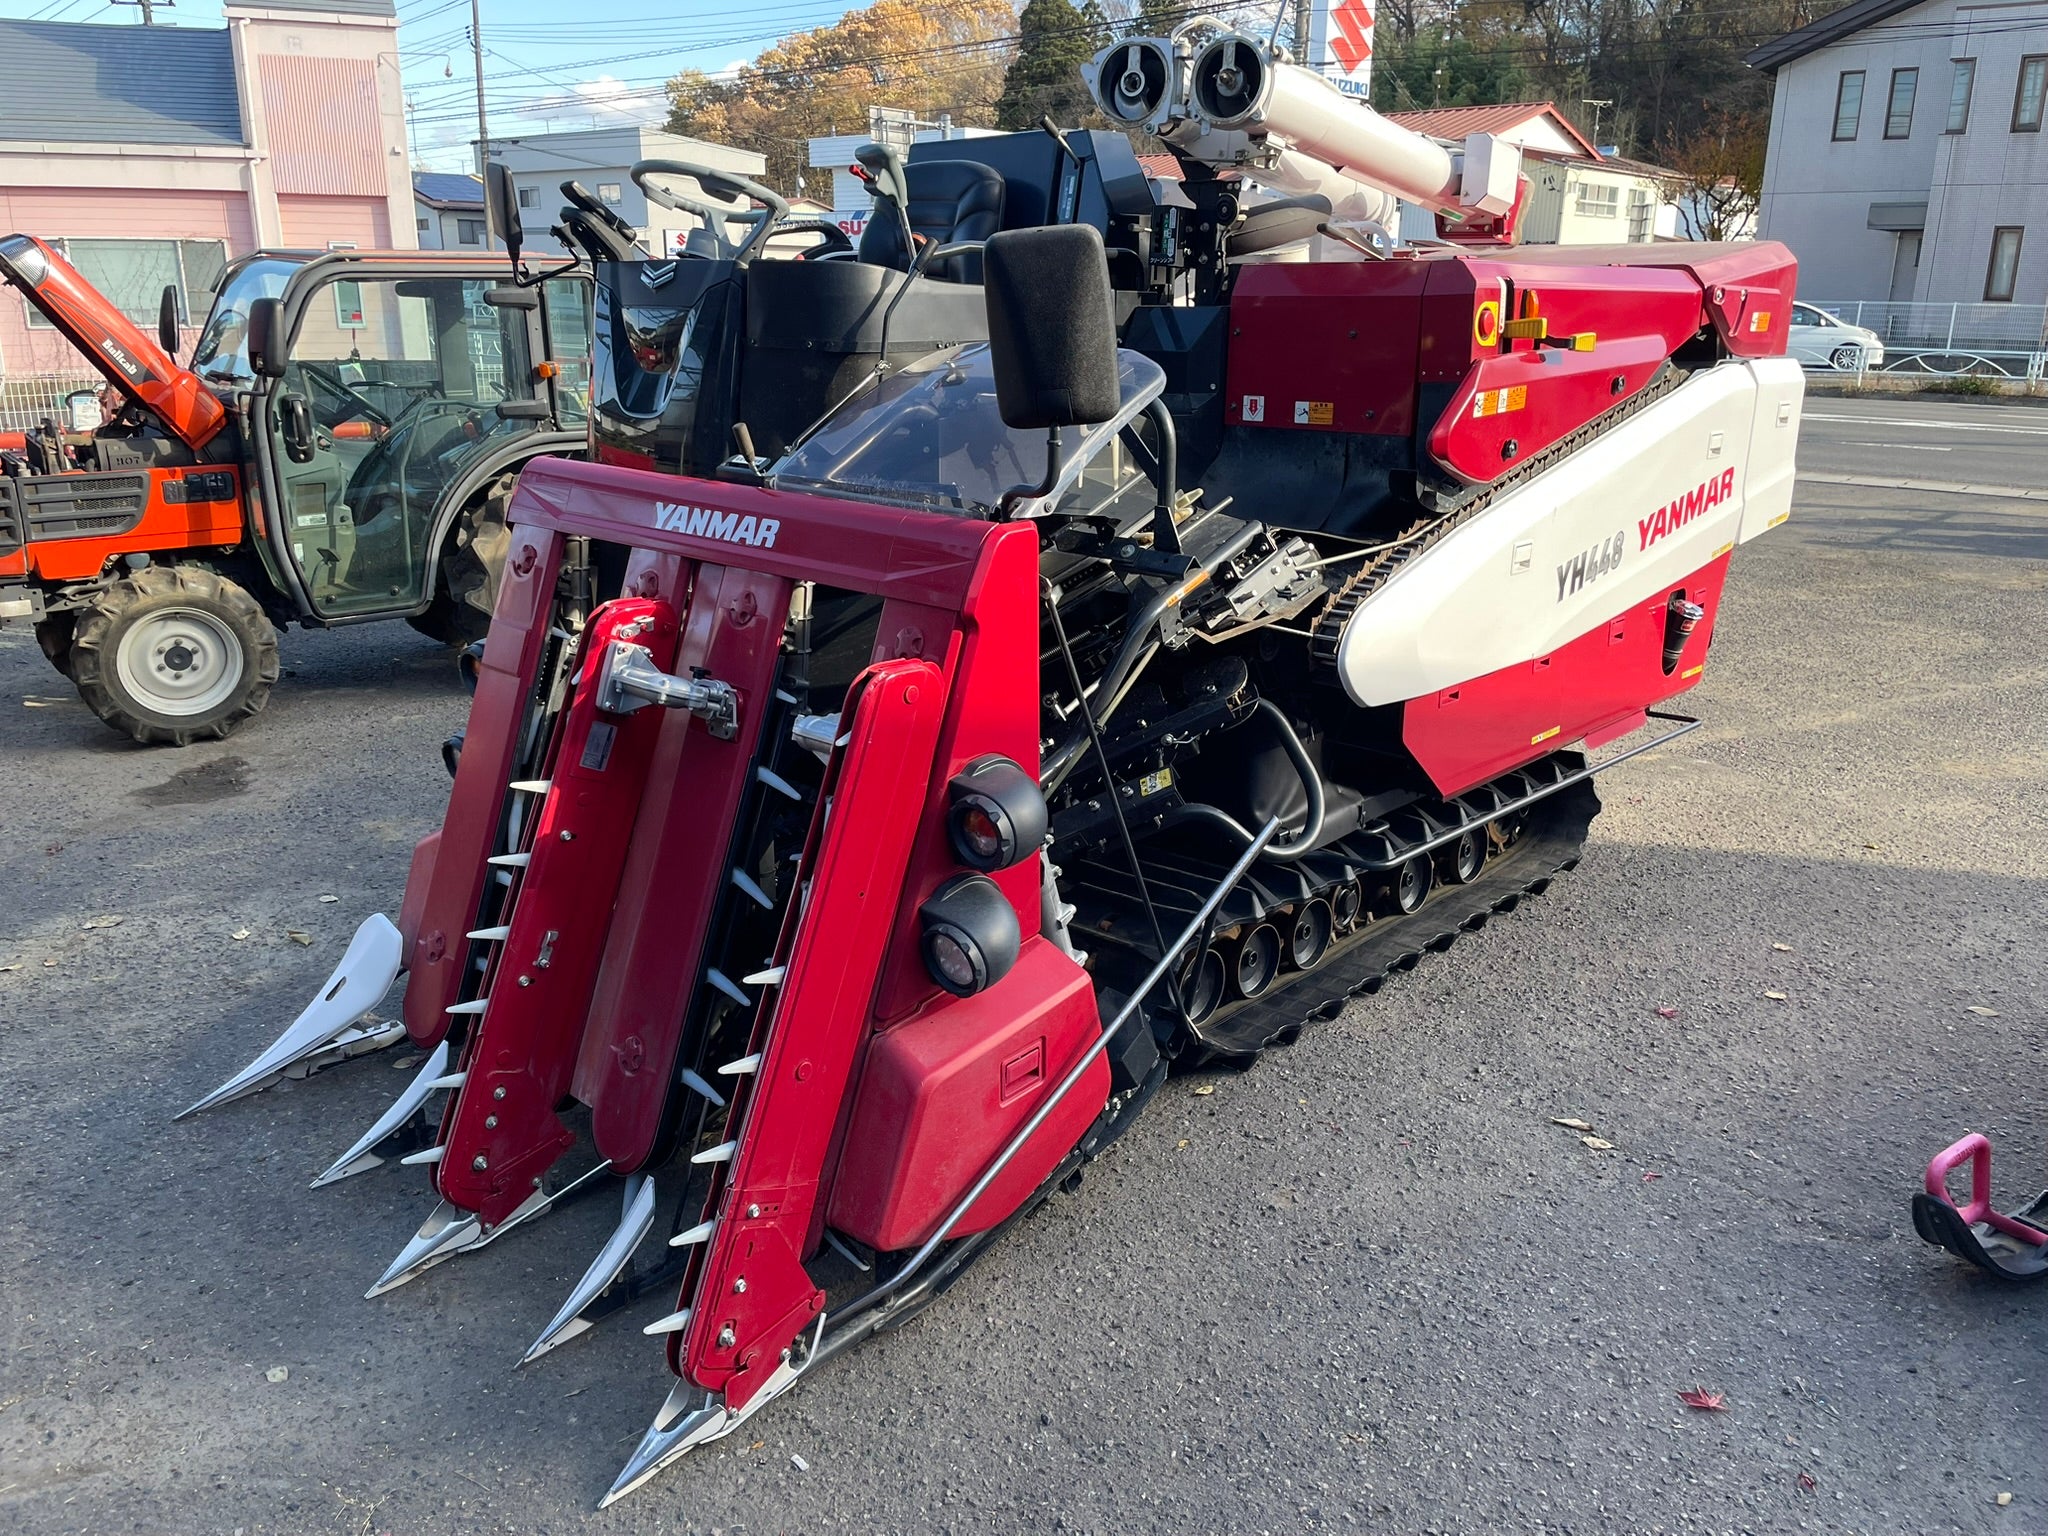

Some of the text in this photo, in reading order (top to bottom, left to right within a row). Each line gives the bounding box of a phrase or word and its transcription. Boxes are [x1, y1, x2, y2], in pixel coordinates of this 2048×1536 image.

[101, 338, 138, 375] Bullcab
[655, 501, 781, 549] YANMAR
[1556, 466, 1735, 604] YH448 YANMAR
